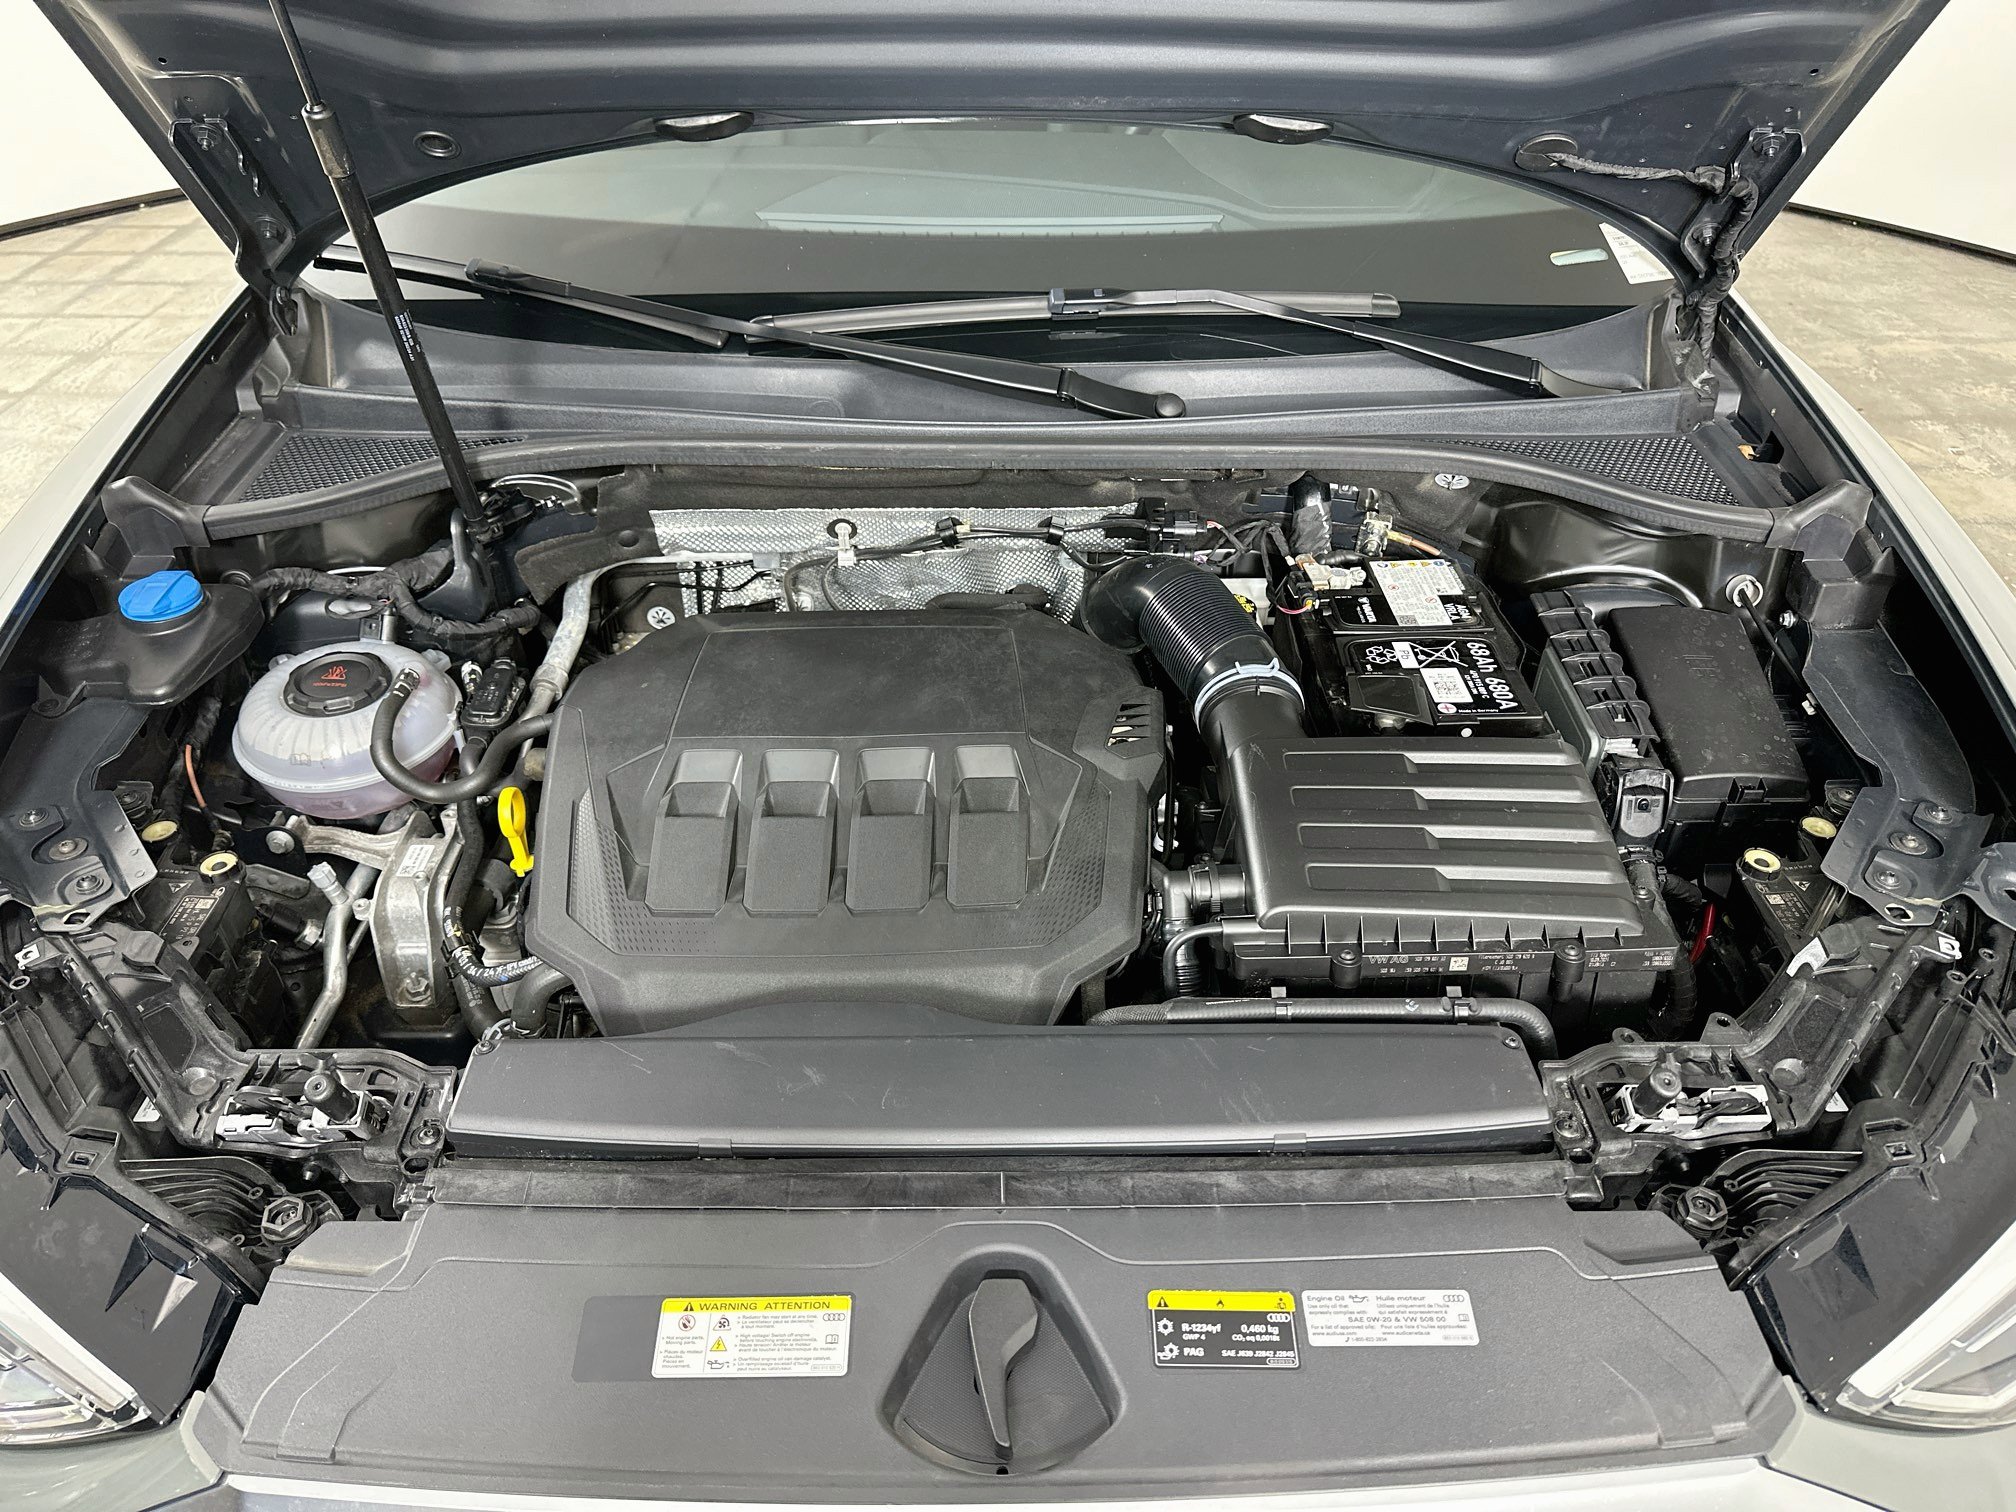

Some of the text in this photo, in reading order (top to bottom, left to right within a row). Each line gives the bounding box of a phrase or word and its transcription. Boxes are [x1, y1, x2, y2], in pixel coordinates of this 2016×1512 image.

[1443, 603, 1461, 621] VRLA
[1455, 604, 1472, 619] AGM
[1466, 641, 1519, 710] 68Ah 680A
[1390, 956, 1409, 964] AG
[699, 1301, 831, 1311] WARNING ATTENTION
[1181, 1323, 1222, 1334] R-1234yf
[1267, 1325, 1280, 1335] kg
[1183, 1347, 1205, 1357] PAG
